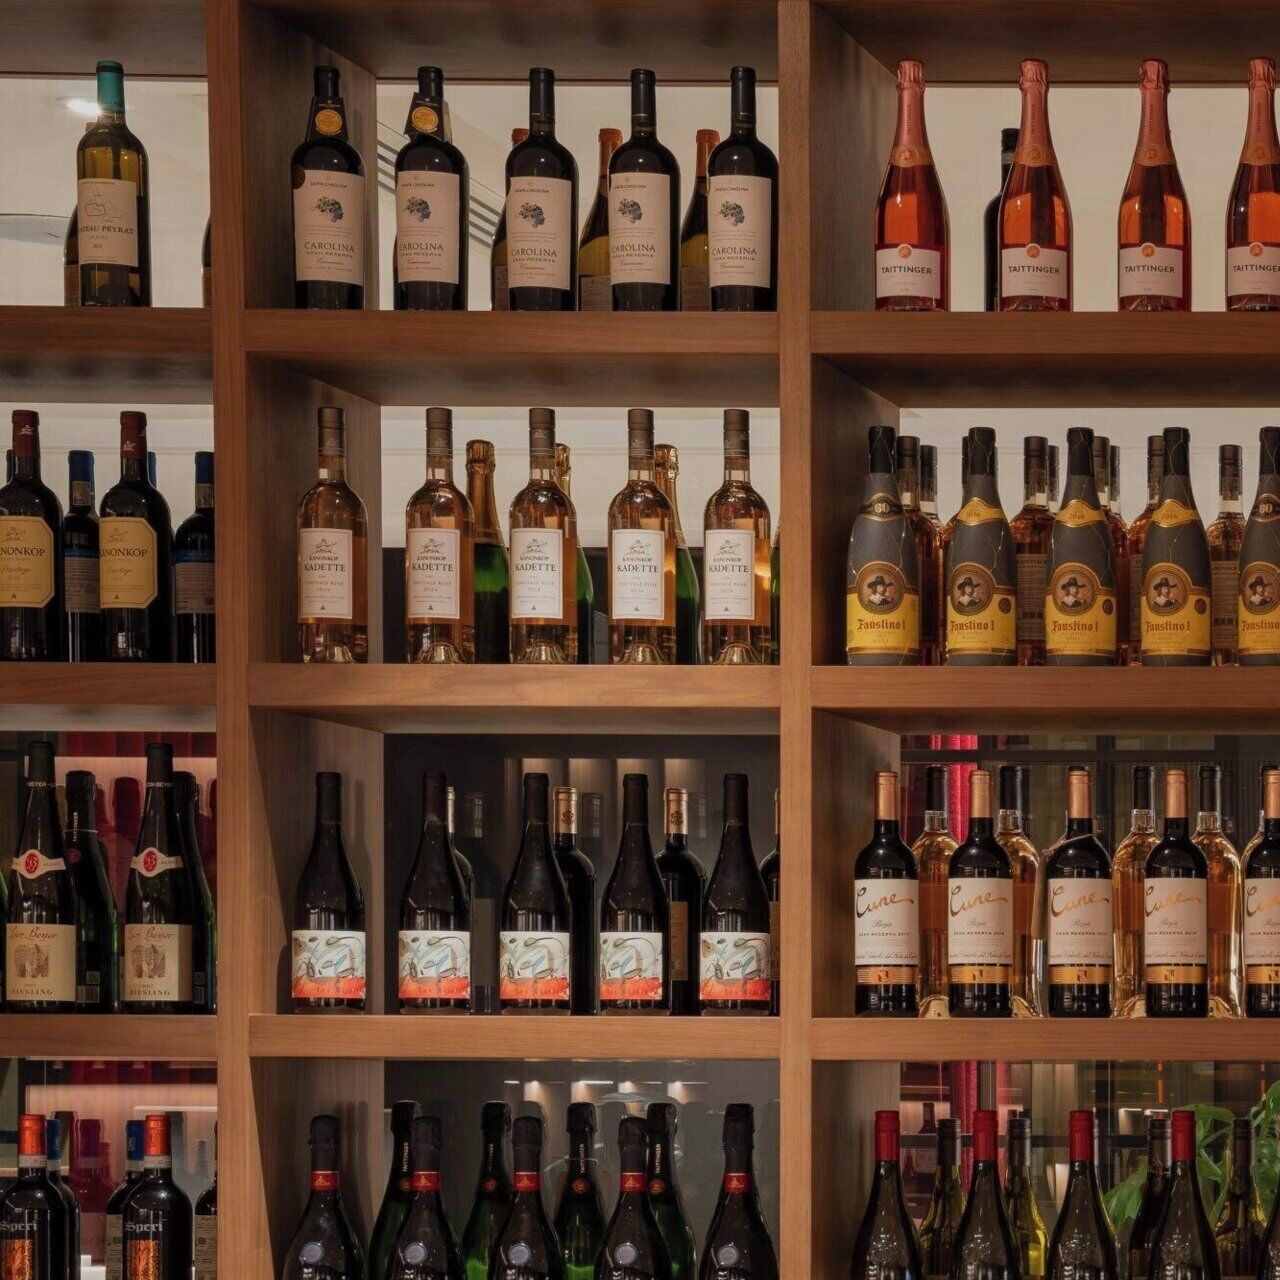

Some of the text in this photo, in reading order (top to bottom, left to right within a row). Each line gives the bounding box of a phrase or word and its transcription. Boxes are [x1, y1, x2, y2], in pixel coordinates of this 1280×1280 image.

[304, 241, 355, 253] CAROLINA
[399, 242, 444, 252] CAROLINA
[612, 243, 656, 253] CAROLINA
[712, 247, 757, 257] CAROLINA
[511, 248, 557, 258] CAROLINA
[881, 265, 932, 275] TAITTINGER
[1008, 265, 1060, 274] TAITTINGER
[1124, 265, 1175, 273] TAITTINGER
[304, 562, 346, 572] KADETTE
[412, 562, 454, 572] KADETTE
[515, 562, 556, 572] KADETTE
[617, 564, 658, 574] KADETTE
[709, 564, 749, 574] KADETTE
[857, 620, 901, 631] Faustino
[951, 620, 990, 631] Faustino
[1052, 621, 1093, 631] Faustino
[1146, 621, 1186, 632] Faustino
[1241, 620, 1280, 631] Faustino
[855, 886, 914, 918] Cune
[951, 886, 1007, 917] Cune
[1051, 886, 1109, 917] Cune
[1145, 886, 1200, 917] Cune
